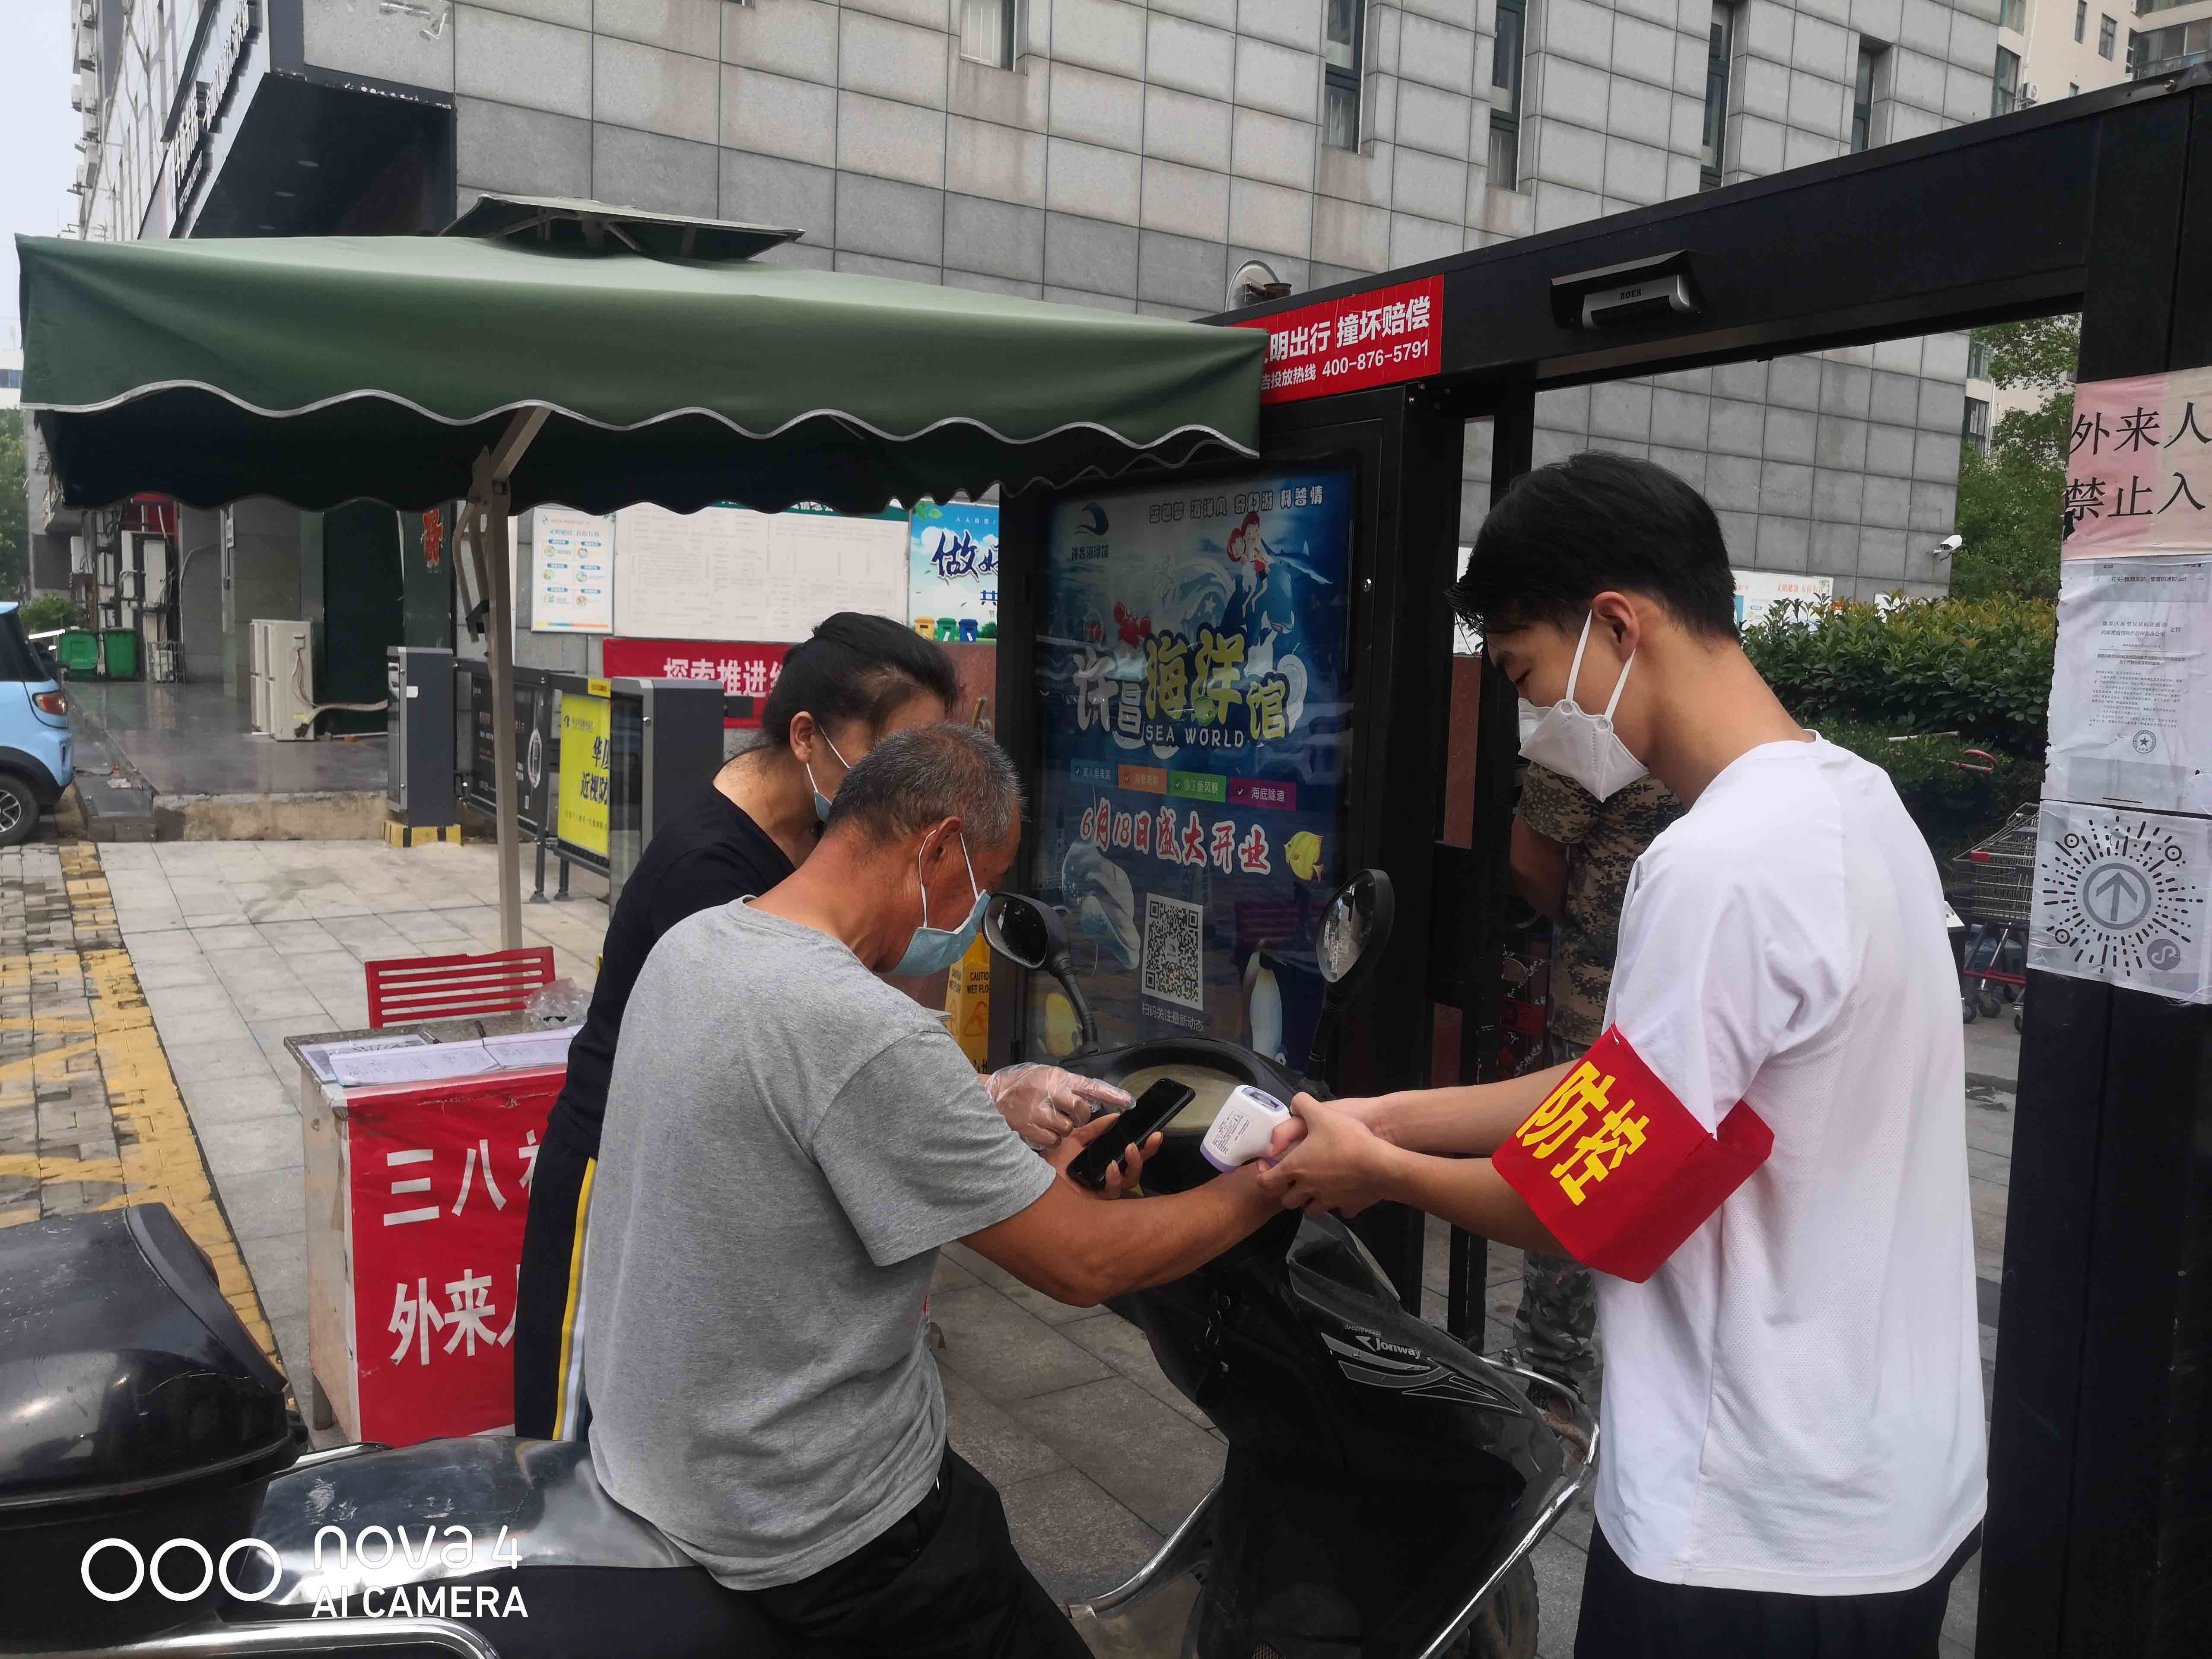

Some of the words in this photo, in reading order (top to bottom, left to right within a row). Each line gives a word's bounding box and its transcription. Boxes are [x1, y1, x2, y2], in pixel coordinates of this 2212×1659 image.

[1264, 320, 1331, 363] 明出行
[1337, 296, 1430, 349] 撞坏赔偿
[1322, 339, 1429, 378] 400-876-5791
[2069, 402, 2212, 455] 外来人
[2063, 471, 2206, 521] 禁止入
[1146, 725, 1175, 743] SEA
[1186, 727, 1244, 748] WORLD
[581, 770, 609, 805] 近视防
[1251, 786, 1285, 802] 海底隧道
[1516, 1061, 1650, 1206] 防控
[1376, 1338, 1421, 1360] Jonway
